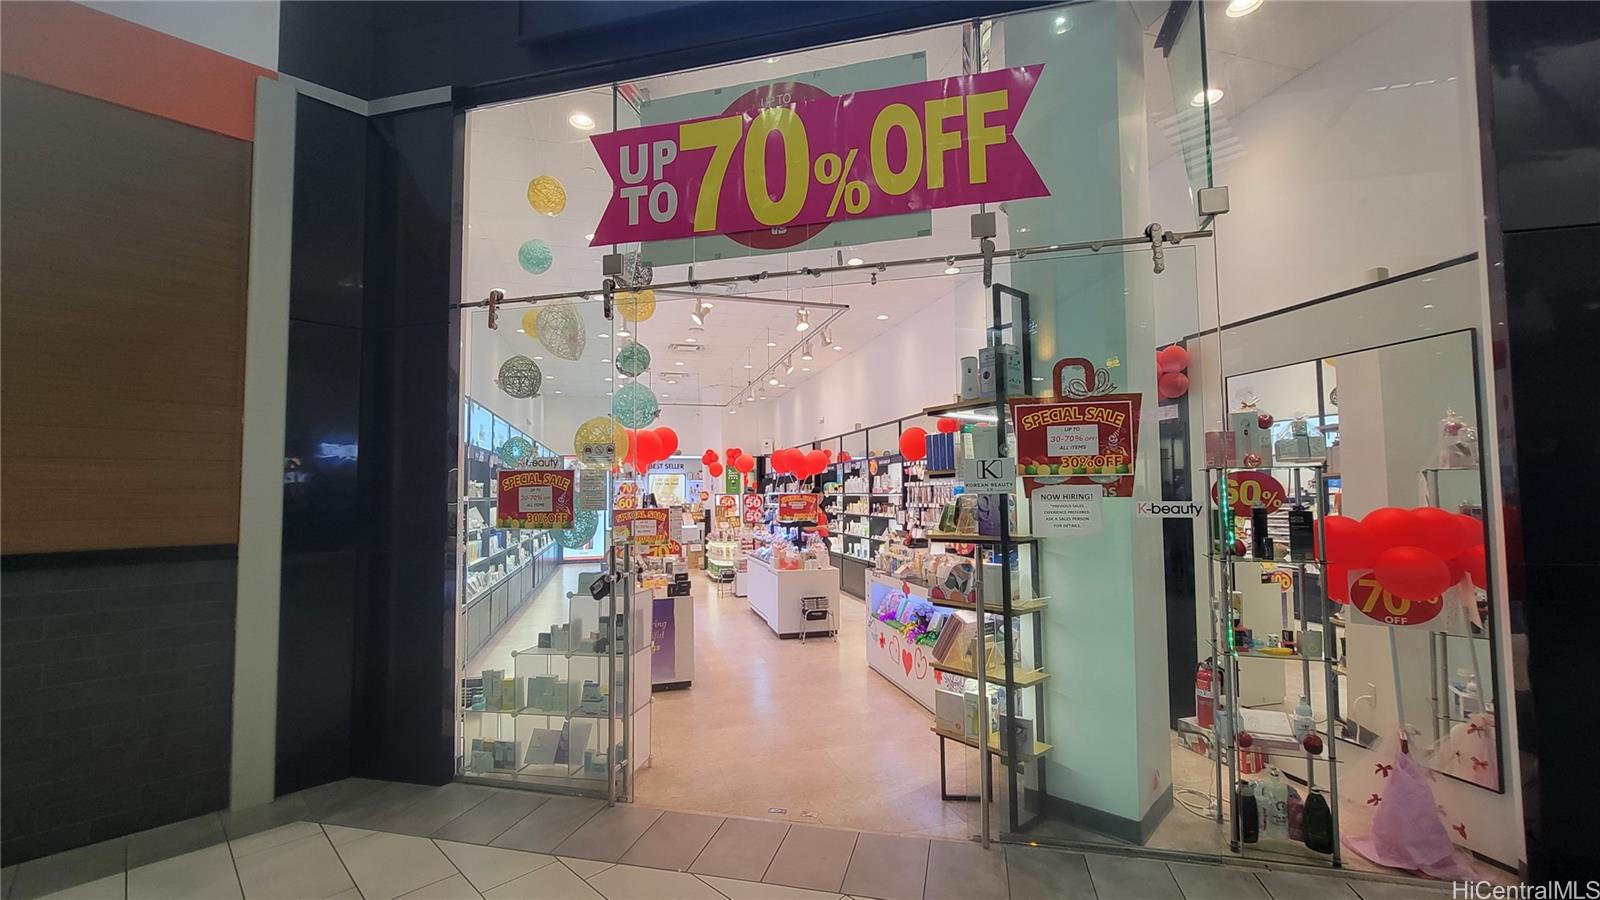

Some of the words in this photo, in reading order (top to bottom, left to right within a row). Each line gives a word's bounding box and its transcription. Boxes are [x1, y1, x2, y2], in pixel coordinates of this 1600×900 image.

[777, 92, 792, 105] TO
[619, 140, 678, 185] UP
[679, 107, 871, 233] 70%
[870, 89, 1009, 197] OFF
[620, 183, 679, 226] TO
[1021, 405, 1083, 431] SPECIAL
[1084, 406, 1126, 428] SALE
[1050, 435, 1084, 443] 30-70%
[979, 460, 1001, 479] K
[501, 472, 542, 492] SPECIAL
[542, 472, 571, 491] SALE
[1040, 493, 1061, 501] NOW
[1062, 493, 1094, 501] HIRING!
[1138, 502, 1203, 517] K-beauty
[1359, 579, 1439, 616] 70
[1384, 615, 1408, 625] OFF
